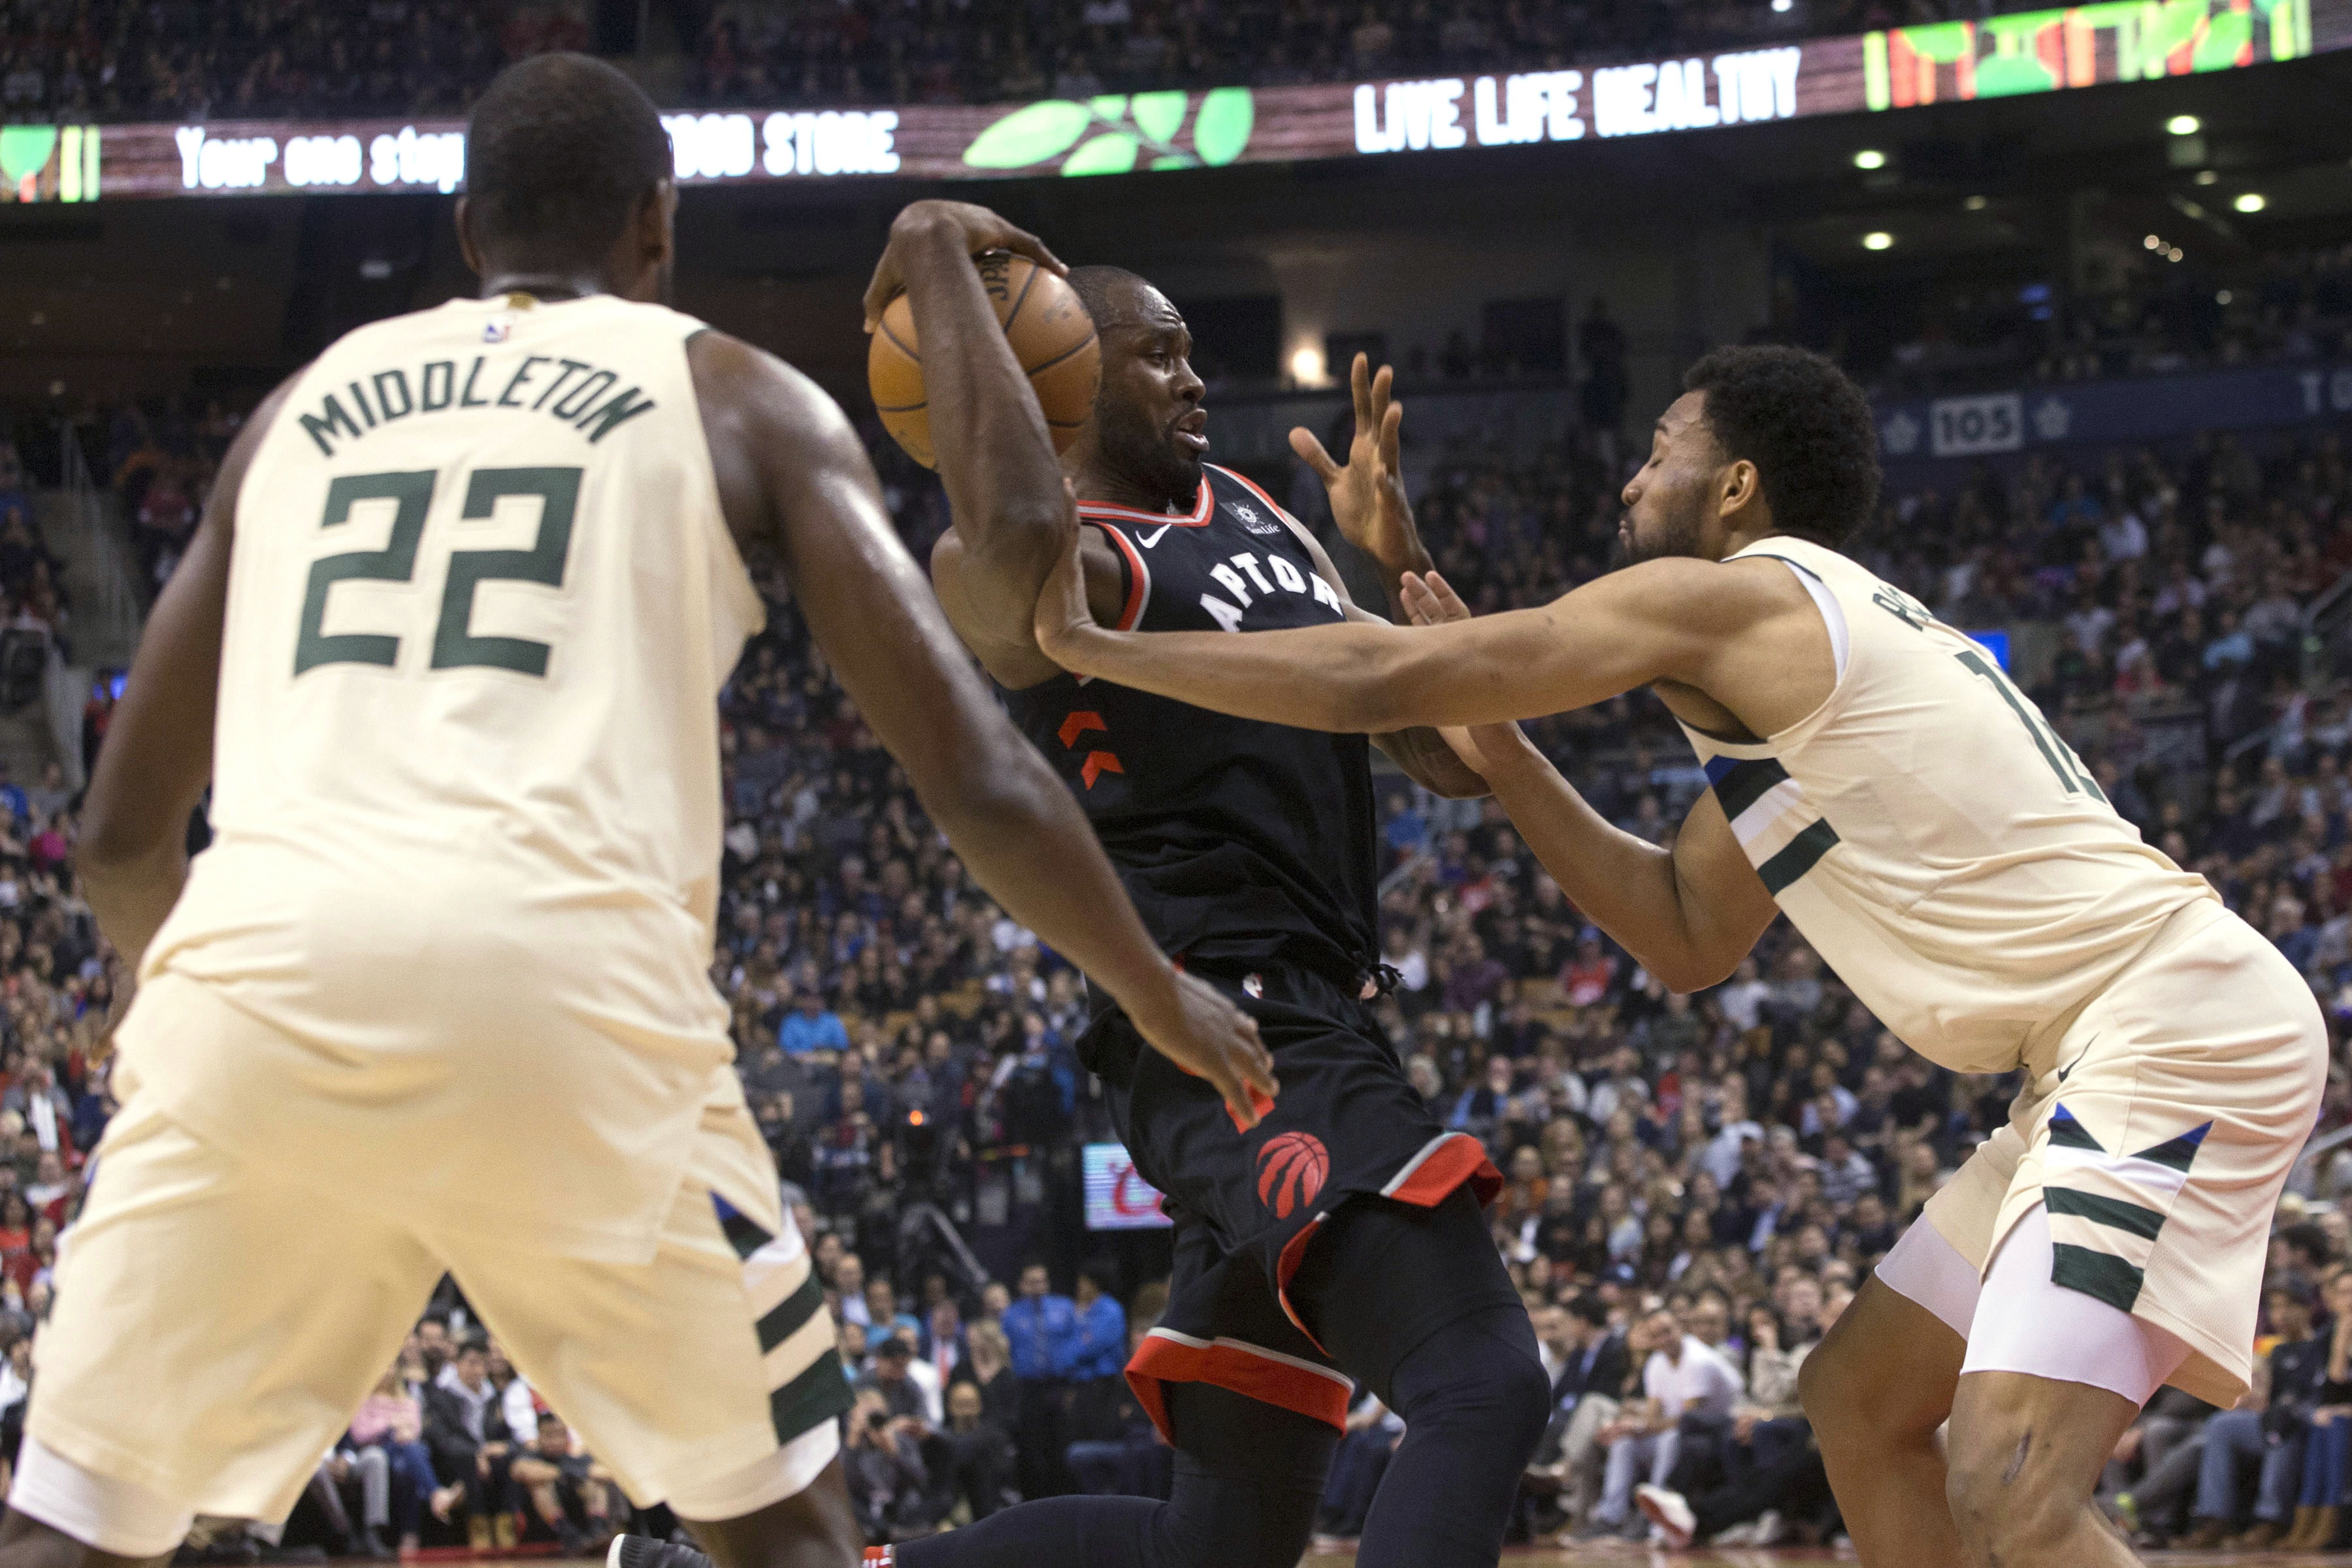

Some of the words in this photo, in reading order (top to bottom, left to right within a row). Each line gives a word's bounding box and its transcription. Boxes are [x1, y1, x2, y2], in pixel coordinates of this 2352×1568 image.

[1354, 79, 1466, 152] LIVE
[1475, 71, 1585, 144] LIFE
[1593, 47, 1801, 137] HEALTHY
[175, 127, 278, 188] Your
[284, 135, 363, 186] one
[370, 126, 465, 193] stop
[660, 114, 755, 178] OOD
[762, 111, 901, 175] STORE
[299, 356, 656, 457] MIDDLETON
[1939, 405, 2012, 445] 105
[293, 466, 585, 678] 22
[1200, 552, 1343, 632] APTOR
